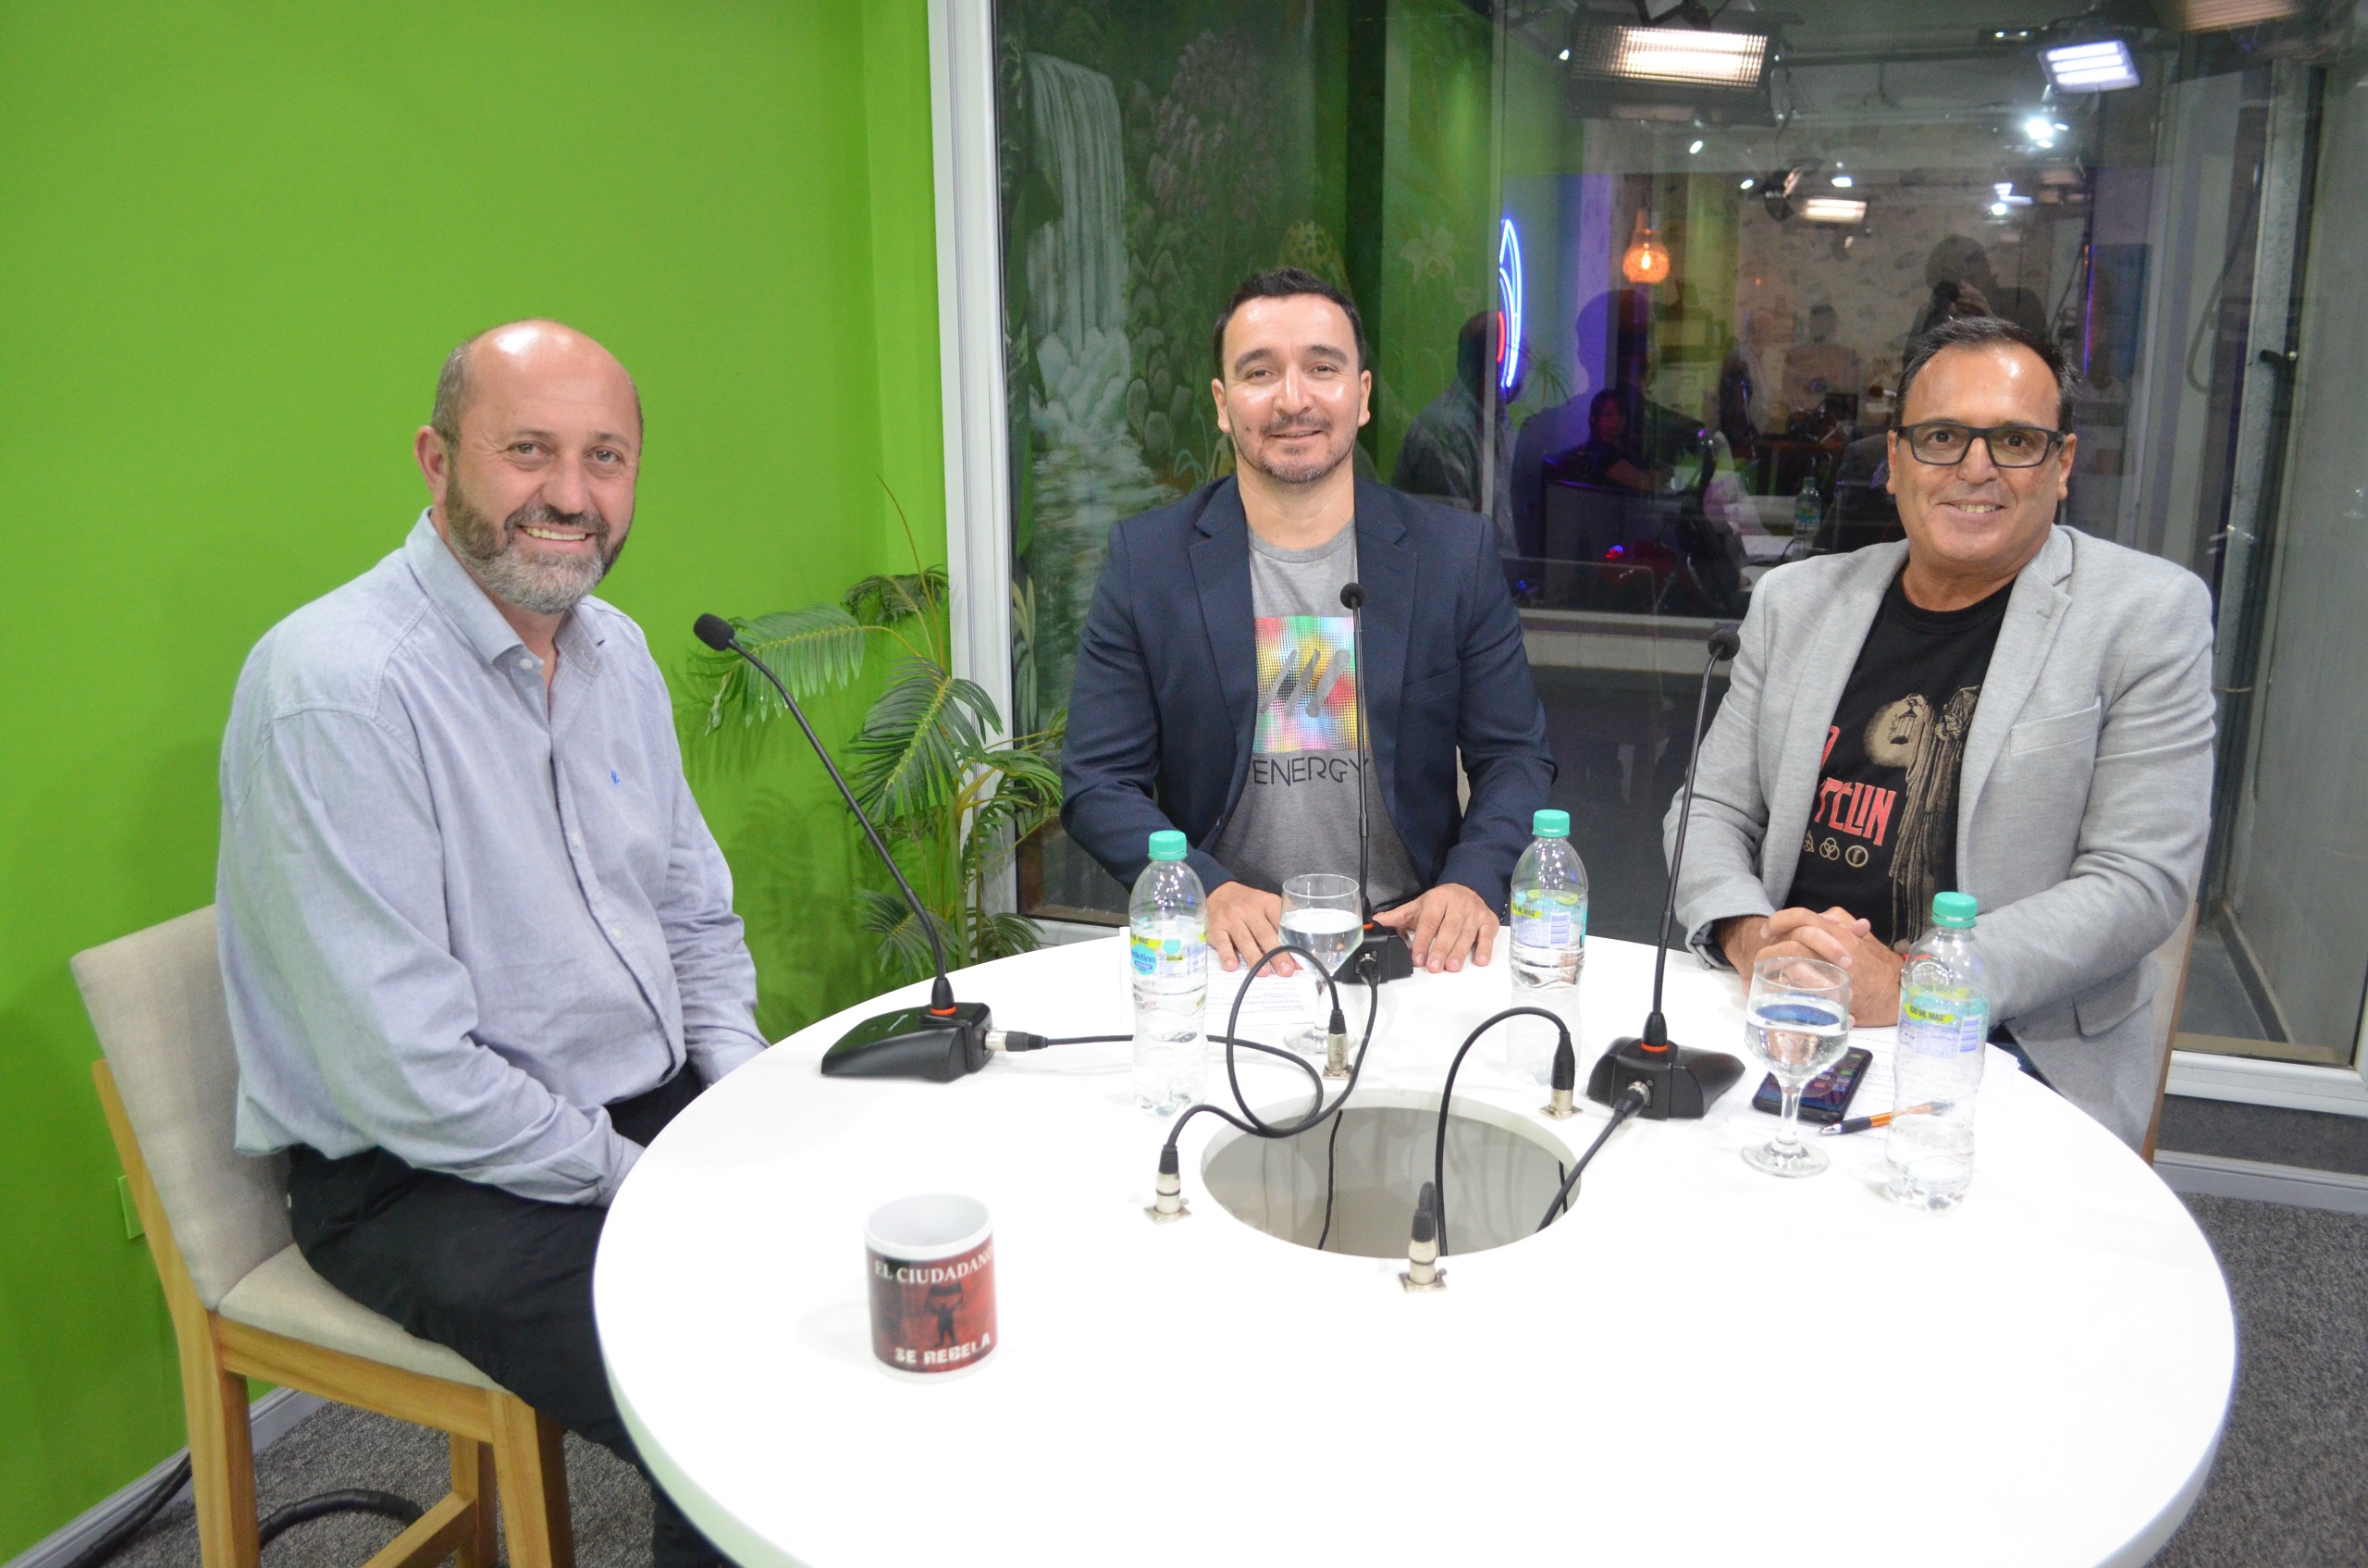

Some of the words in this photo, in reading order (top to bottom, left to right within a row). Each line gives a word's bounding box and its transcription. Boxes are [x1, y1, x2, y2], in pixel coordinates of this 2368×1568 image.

[1252, 756, 1369, 787] ENERGY
[874, 1259, 893, 1281] EL
[896, 1245, 993, 1284] CIUDADANO
[894, 1347, 917, 1364] SE
[924, 1331, 991, 1364] REBELA
